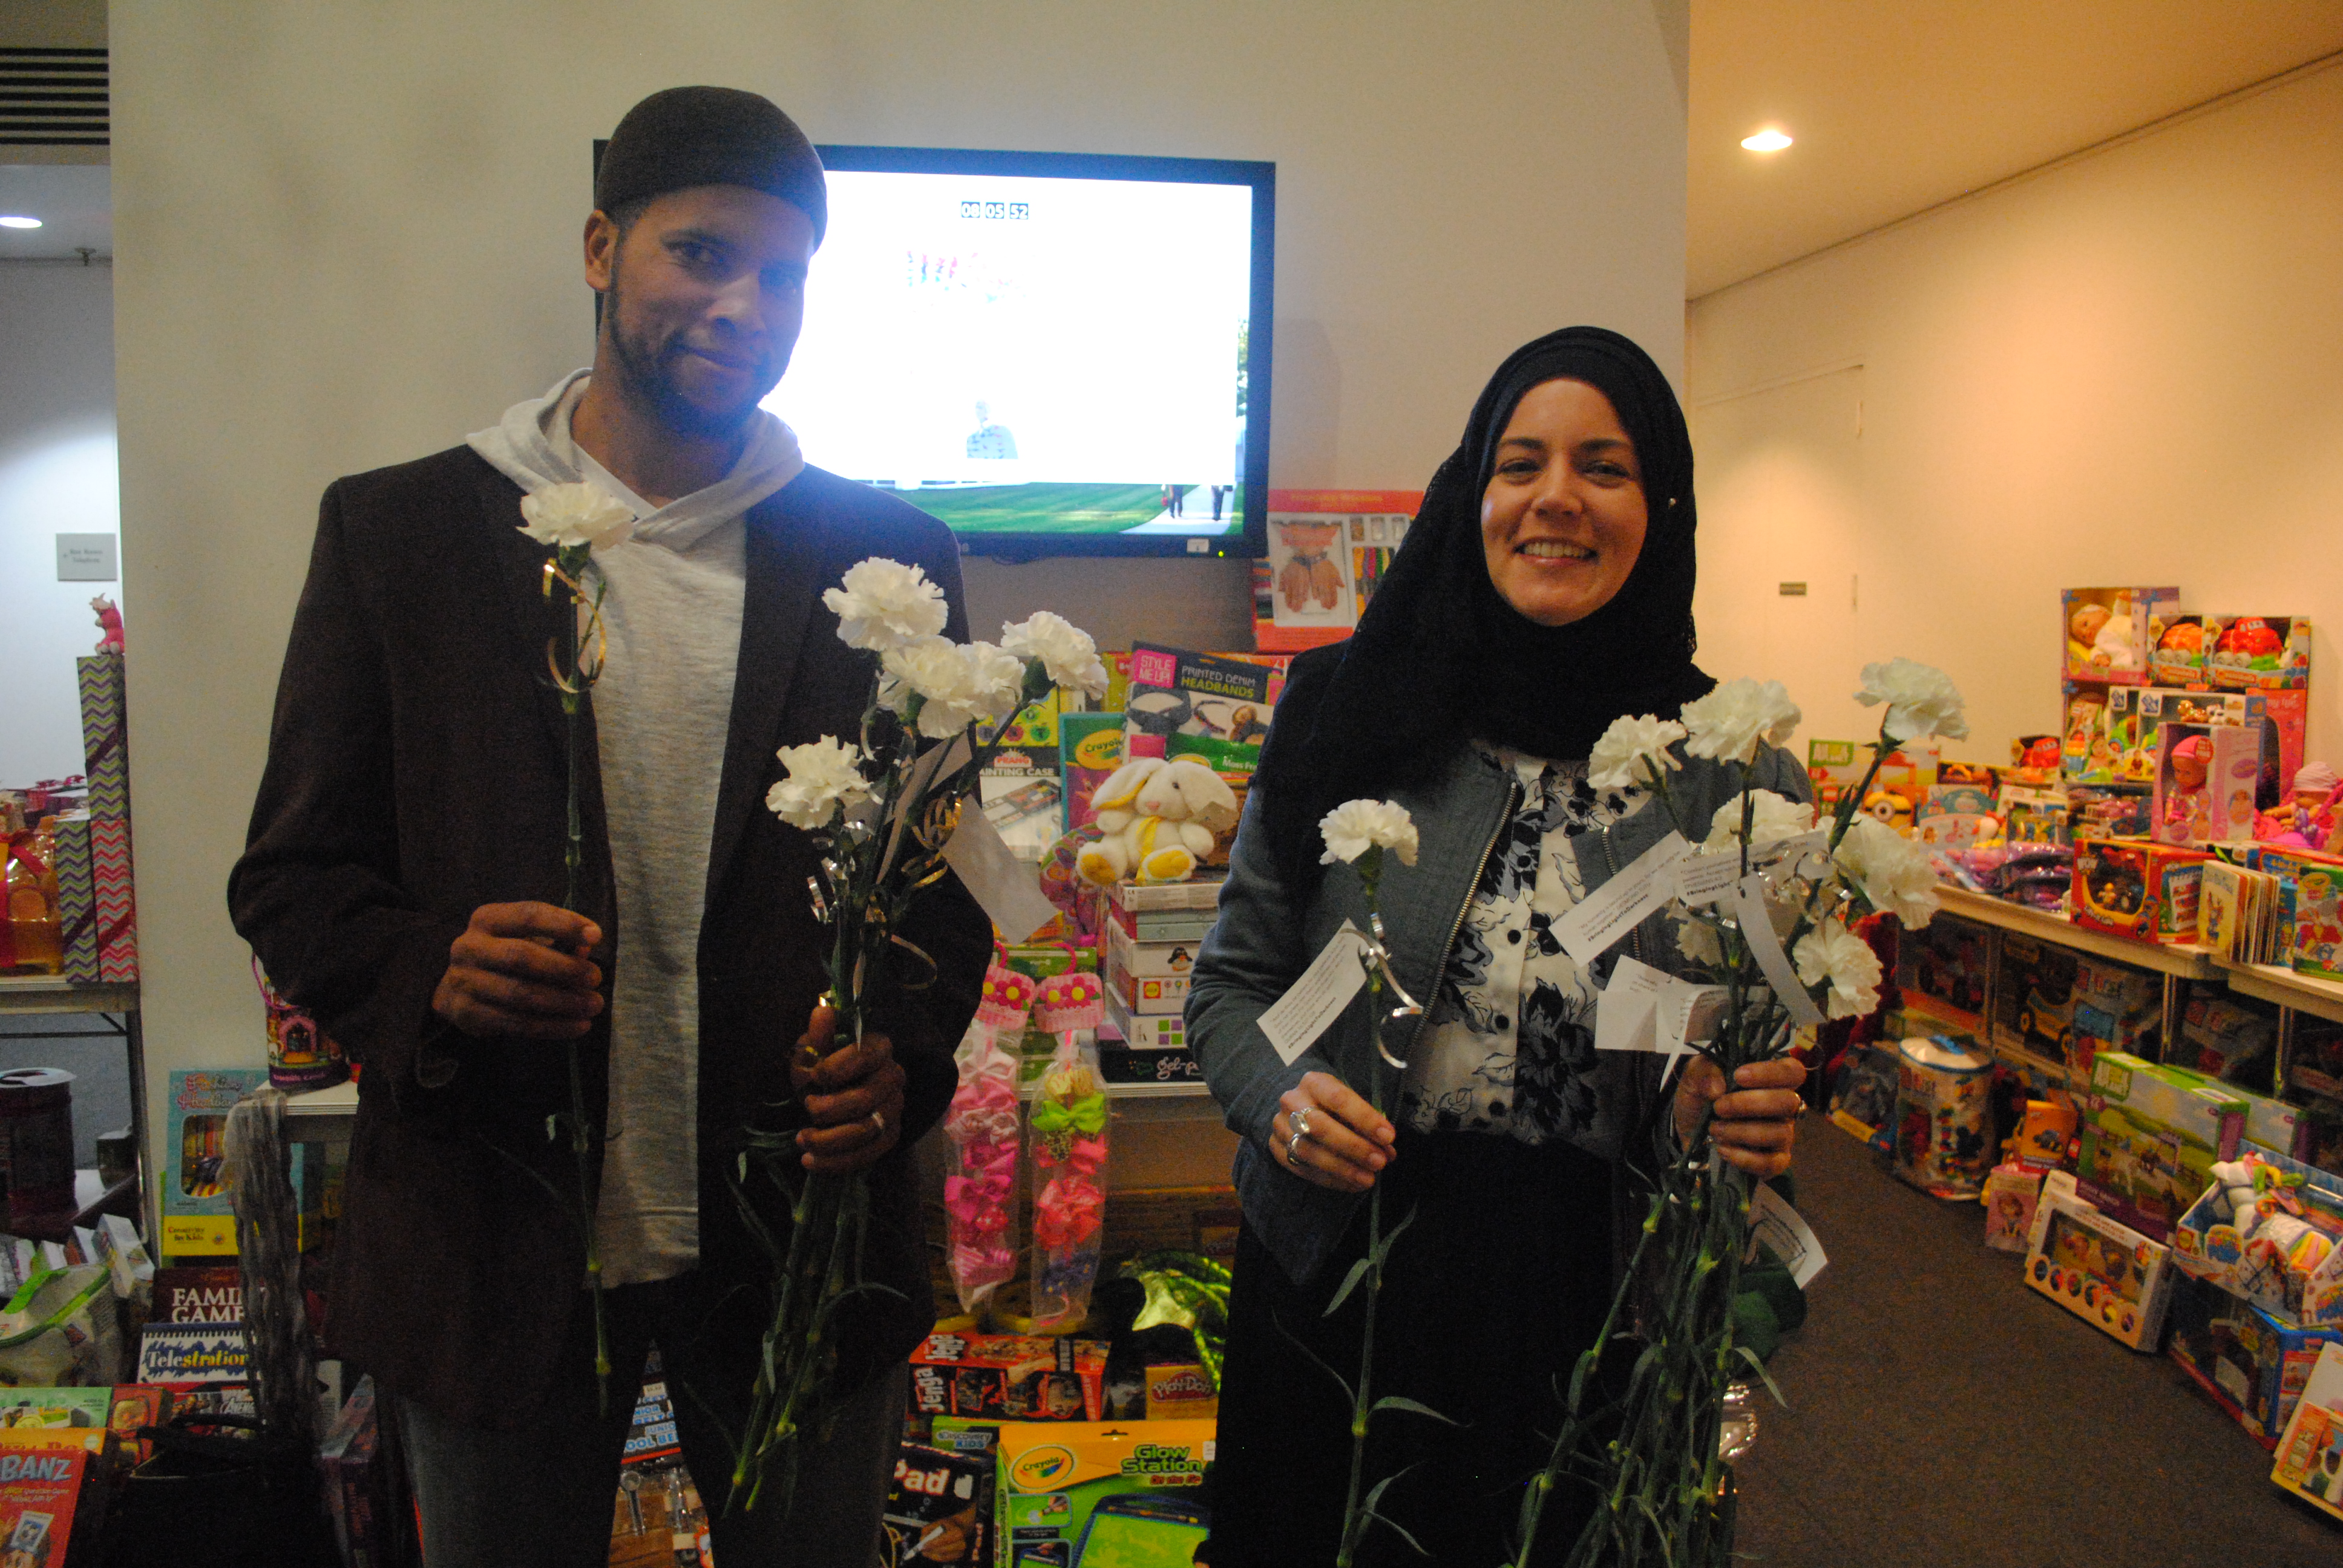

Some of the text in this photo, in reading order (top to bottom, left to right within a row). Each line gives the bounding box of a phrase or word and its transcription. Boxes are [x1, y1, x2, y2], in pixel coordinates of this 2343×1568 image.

[962, 203, 1028, 219] 08 05 52
[1140, 655, 1172, 670] STYLE
[1182, 665, 1256, 687] PRINTED DENIM
[1181, 677, 1254, 698] HEADBANDS
[1027, 768, 1055, 776] CASE
[914, 1368, 946, 1411] Jenga
[626, 1437, 655, 1450] OOL
[1134, 1443, 1190, 1459] Glow
[1, 1454, 72, 1481] BANZ
[1023, 1457, 1060, 1472] Crayola
[1121, 1458, 1202, 1473] Station
